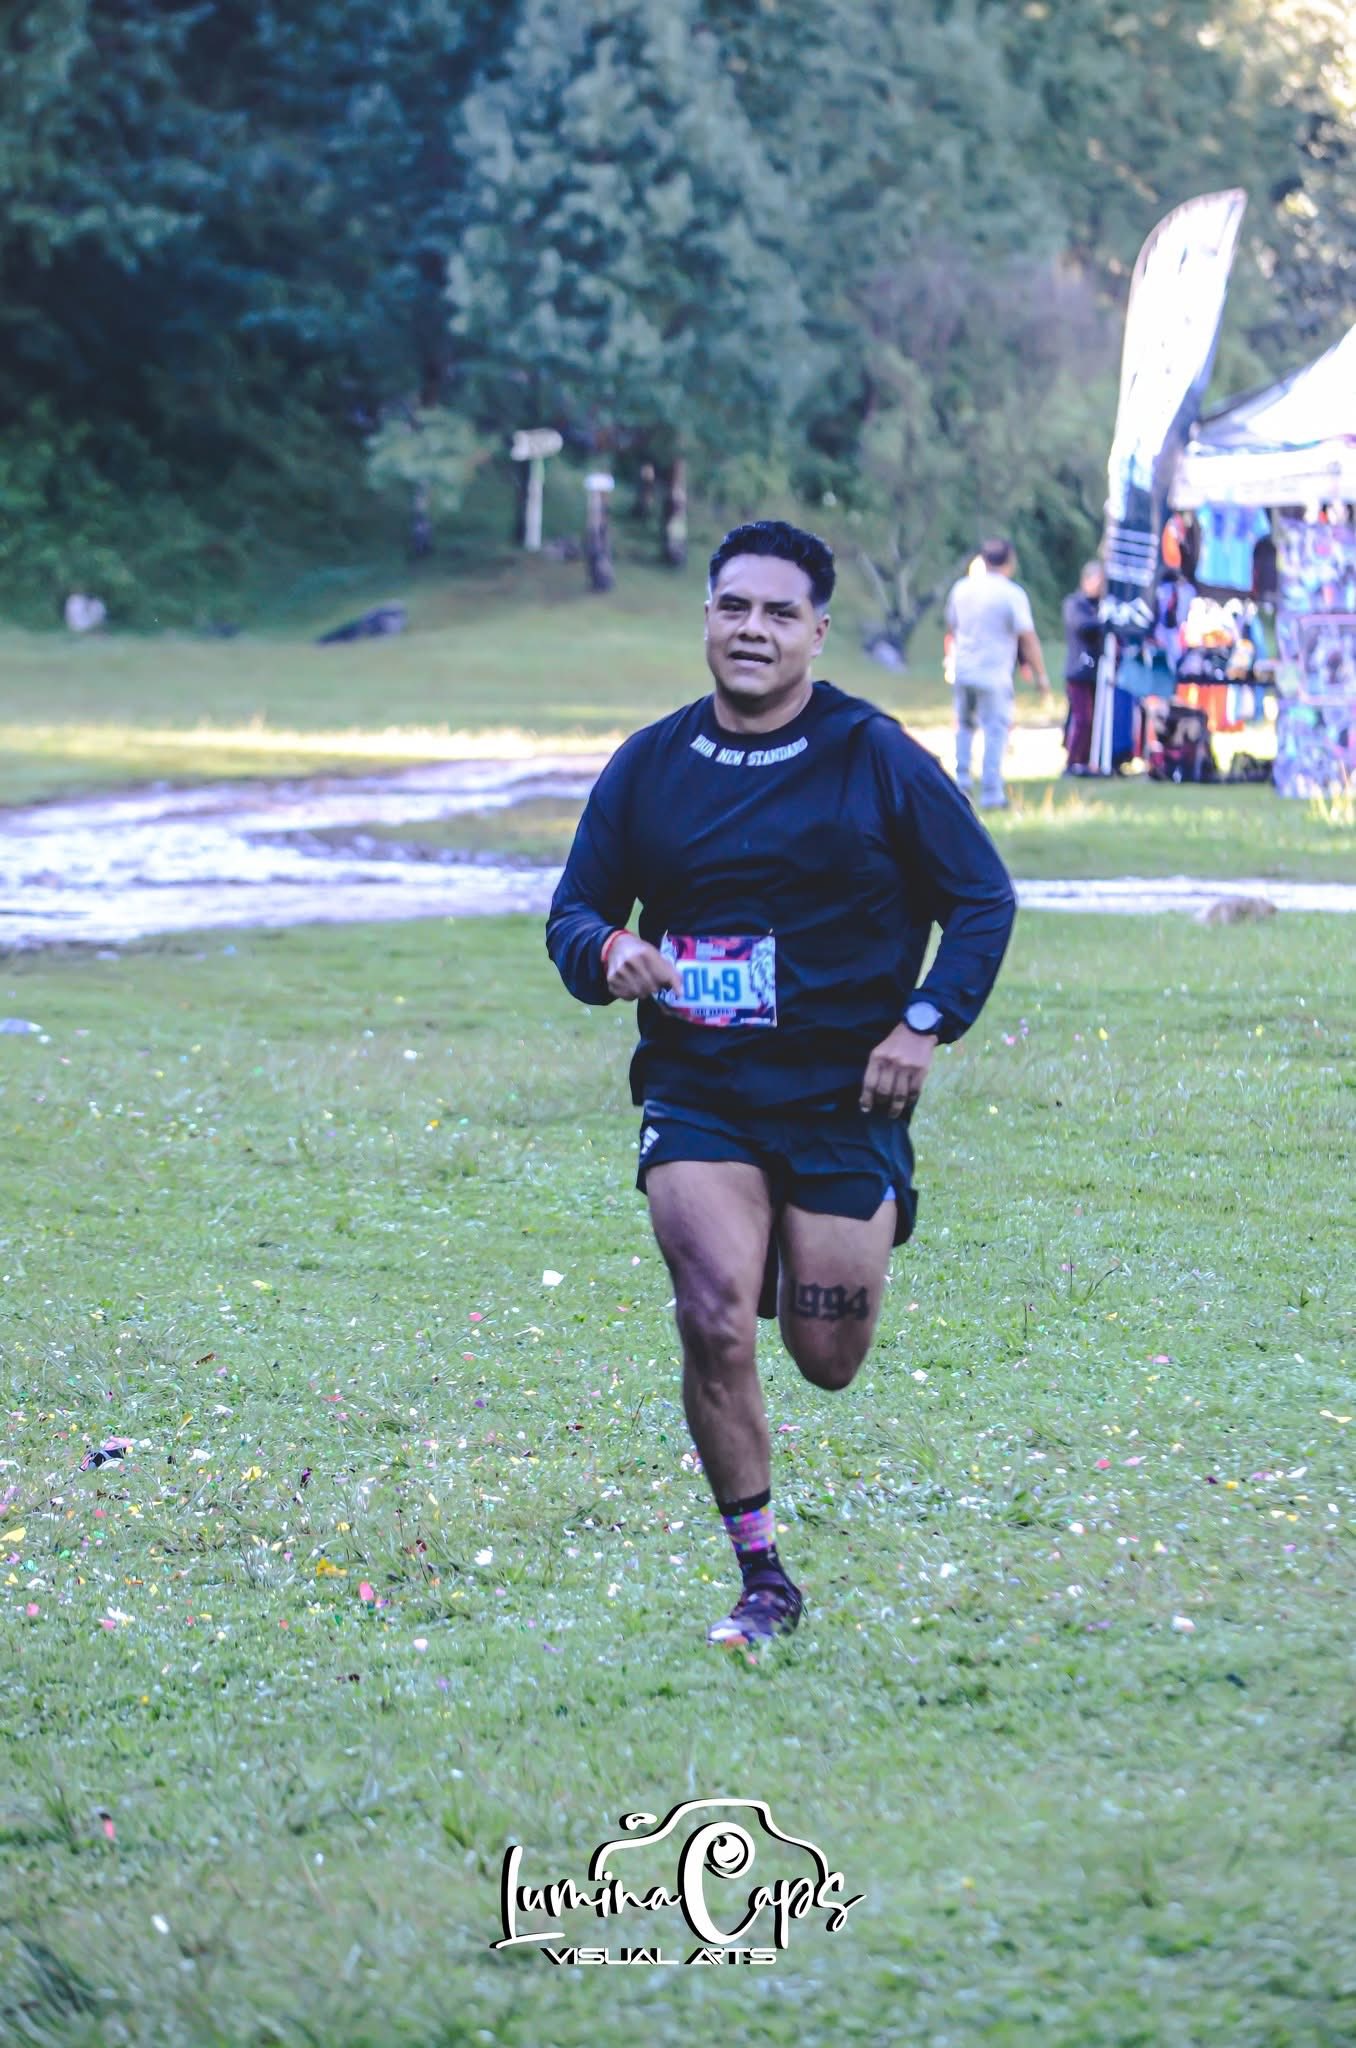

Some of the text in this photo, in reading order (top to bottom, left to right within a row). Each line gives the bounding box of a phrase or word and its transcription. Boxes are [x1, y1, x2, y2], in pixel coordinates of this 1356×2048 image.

[715, 747, 746, 767] NEW
[746, 736, 809, 767] STANDARD
[682, 967, 742, 1003] 049
